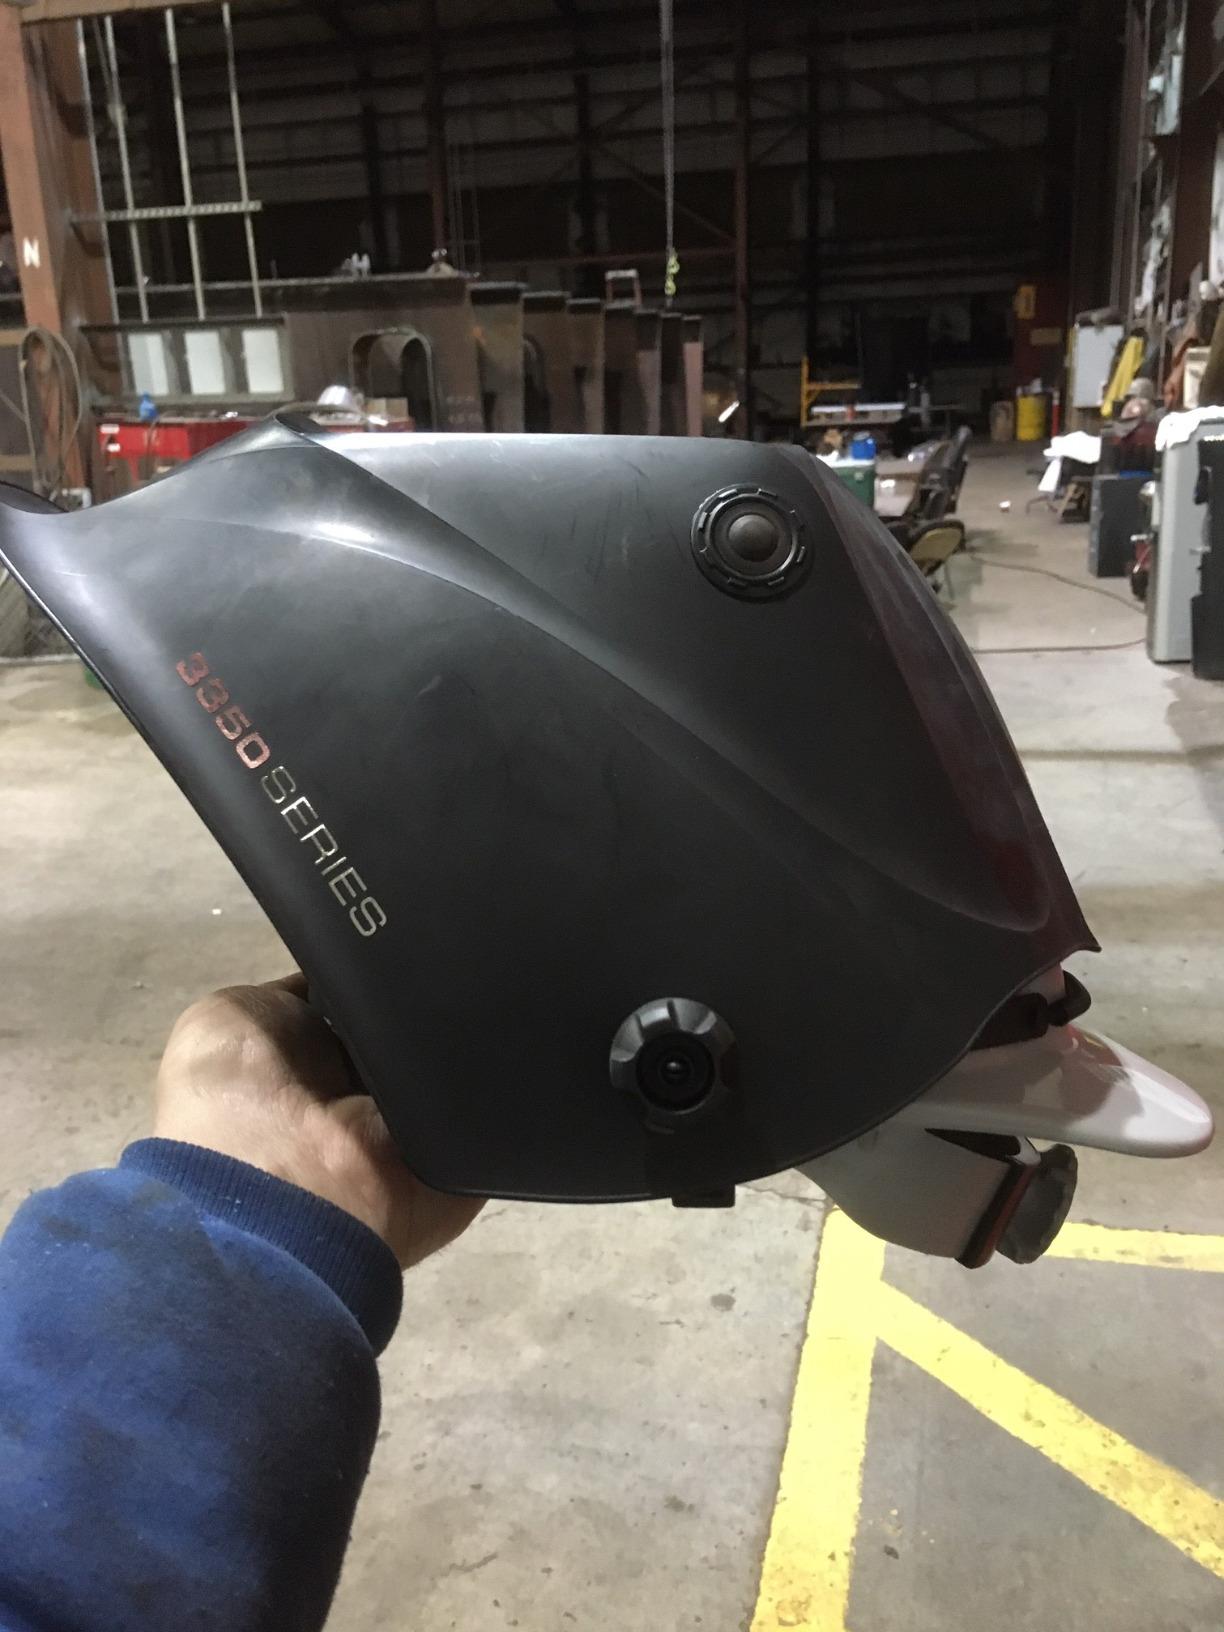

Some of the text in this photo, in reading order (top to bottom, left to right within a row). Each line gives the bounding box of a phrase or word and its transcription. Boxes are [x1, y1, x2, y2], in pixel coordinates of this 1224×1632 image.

[23, 237, 40, 268] N
[176, 652, 387, 937] 3350 SERIES
